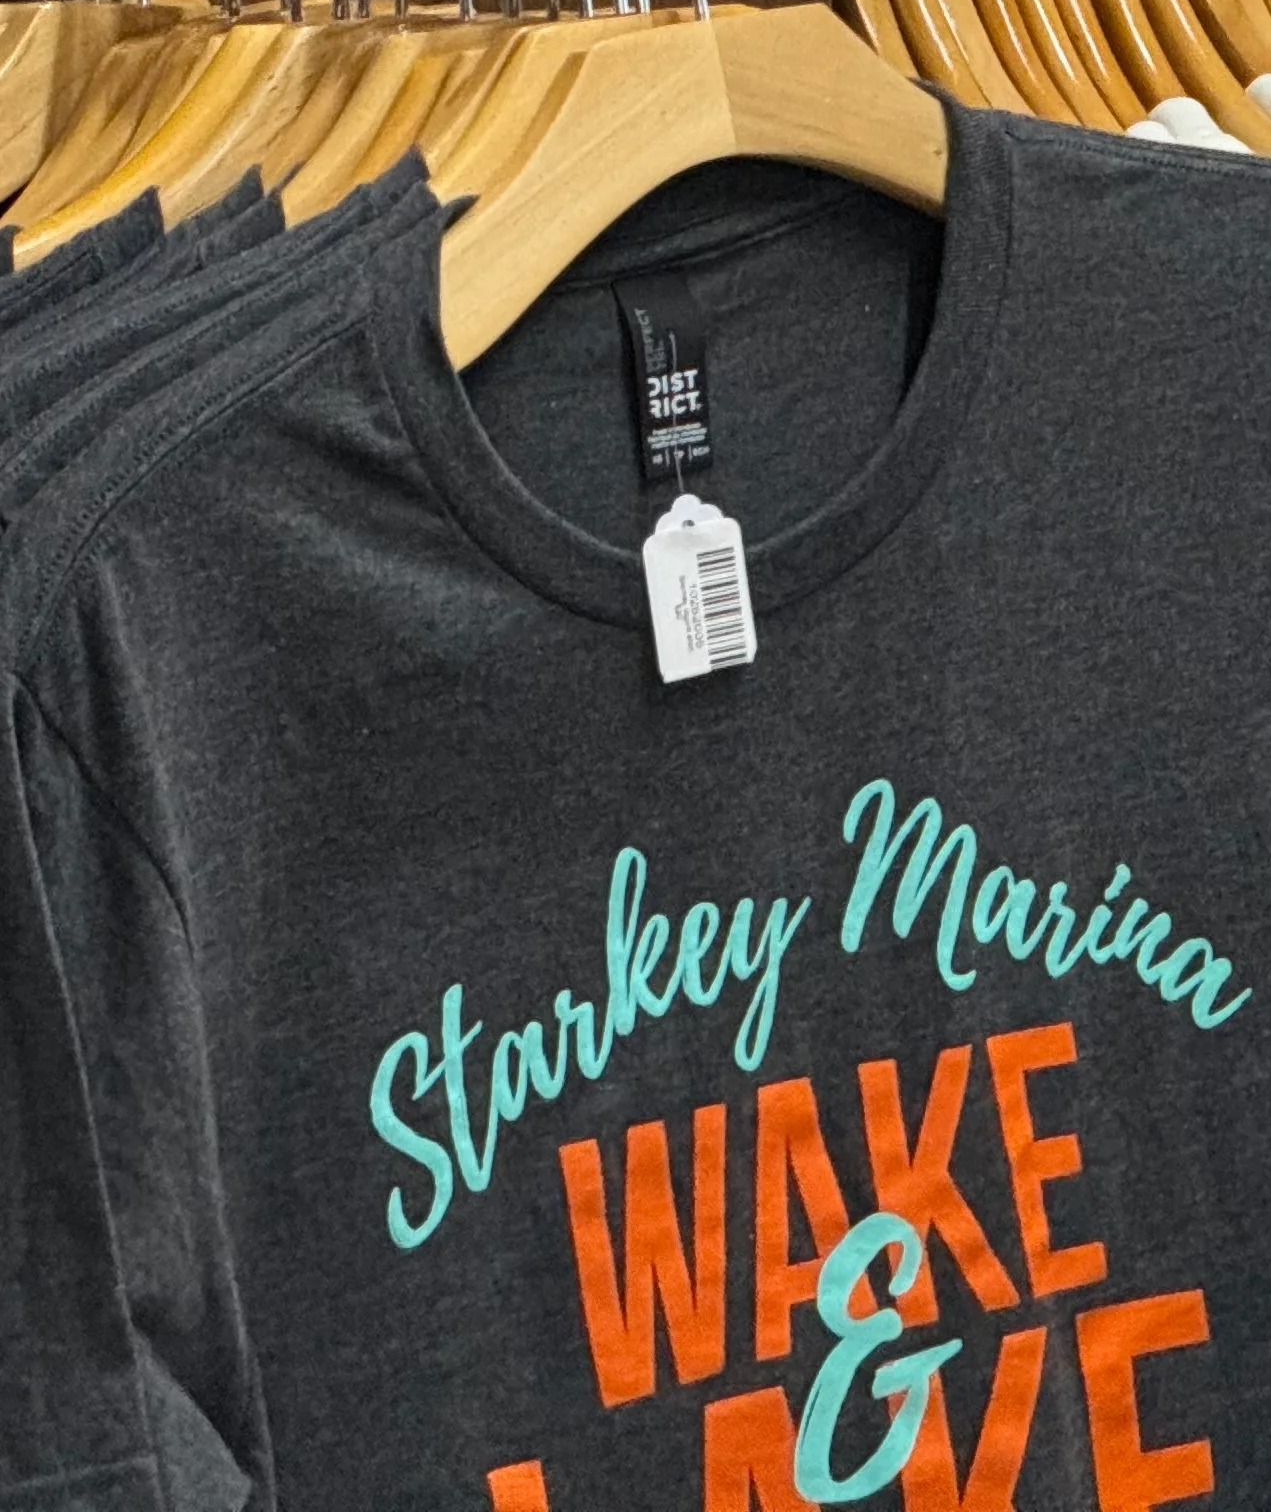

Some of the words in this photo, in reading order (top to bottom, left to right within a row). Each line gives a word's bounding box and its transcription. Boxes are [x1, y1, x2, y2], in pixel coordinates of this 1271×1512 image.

[369, 846, 812, 1249] Starkey
[839, 778, 1252, 1029] Marina
[557, 1021, 1108, 1409] WAKE
